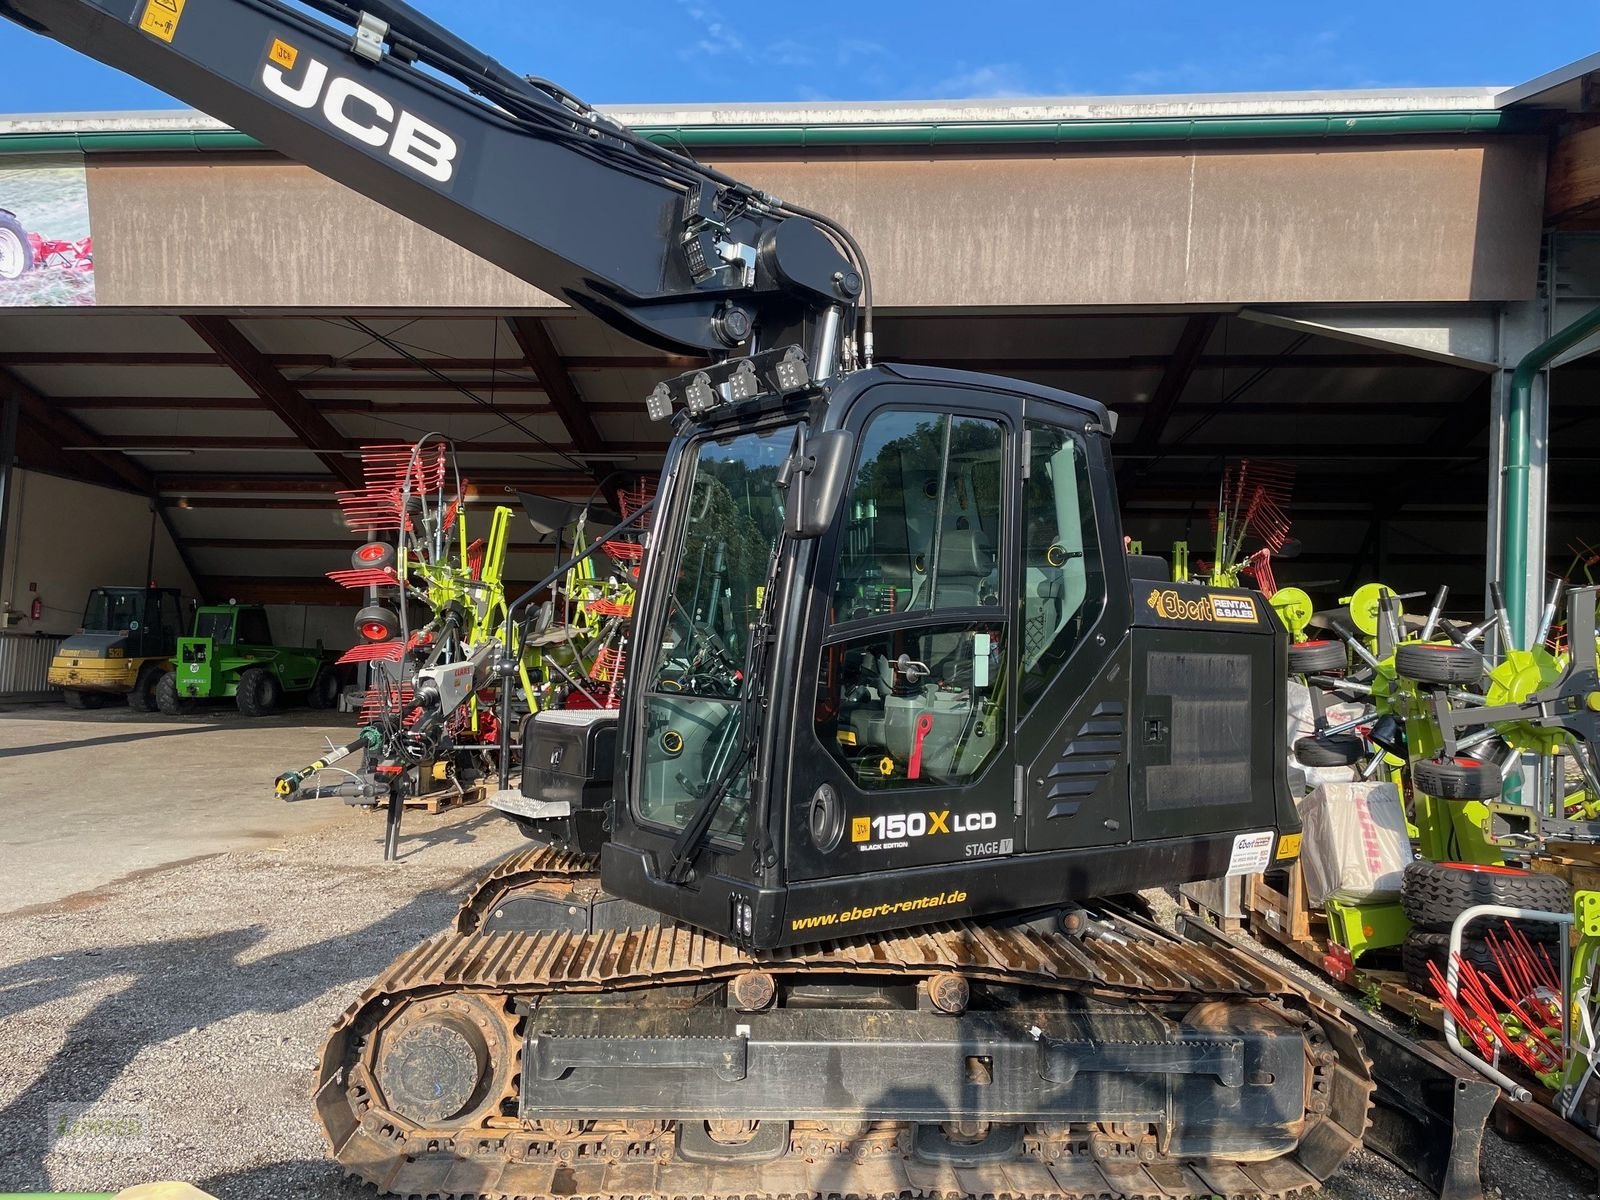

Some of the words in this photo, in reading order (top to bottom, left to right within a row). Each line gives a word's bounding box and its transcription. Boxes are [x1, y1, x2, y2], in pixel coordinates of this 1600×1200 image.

[262, 58, 457, 182] JCB
[1161, 590, 1213, 621] Ebert
[1214, 599, 1252, 609] RENTAL
[953, 812, 997, 832] LCD
[883, 841, 909, 850] EDITION
[965, 841, 998, 857] STAGE
[792, 890, 967, 931] www.ebert-rental.de
